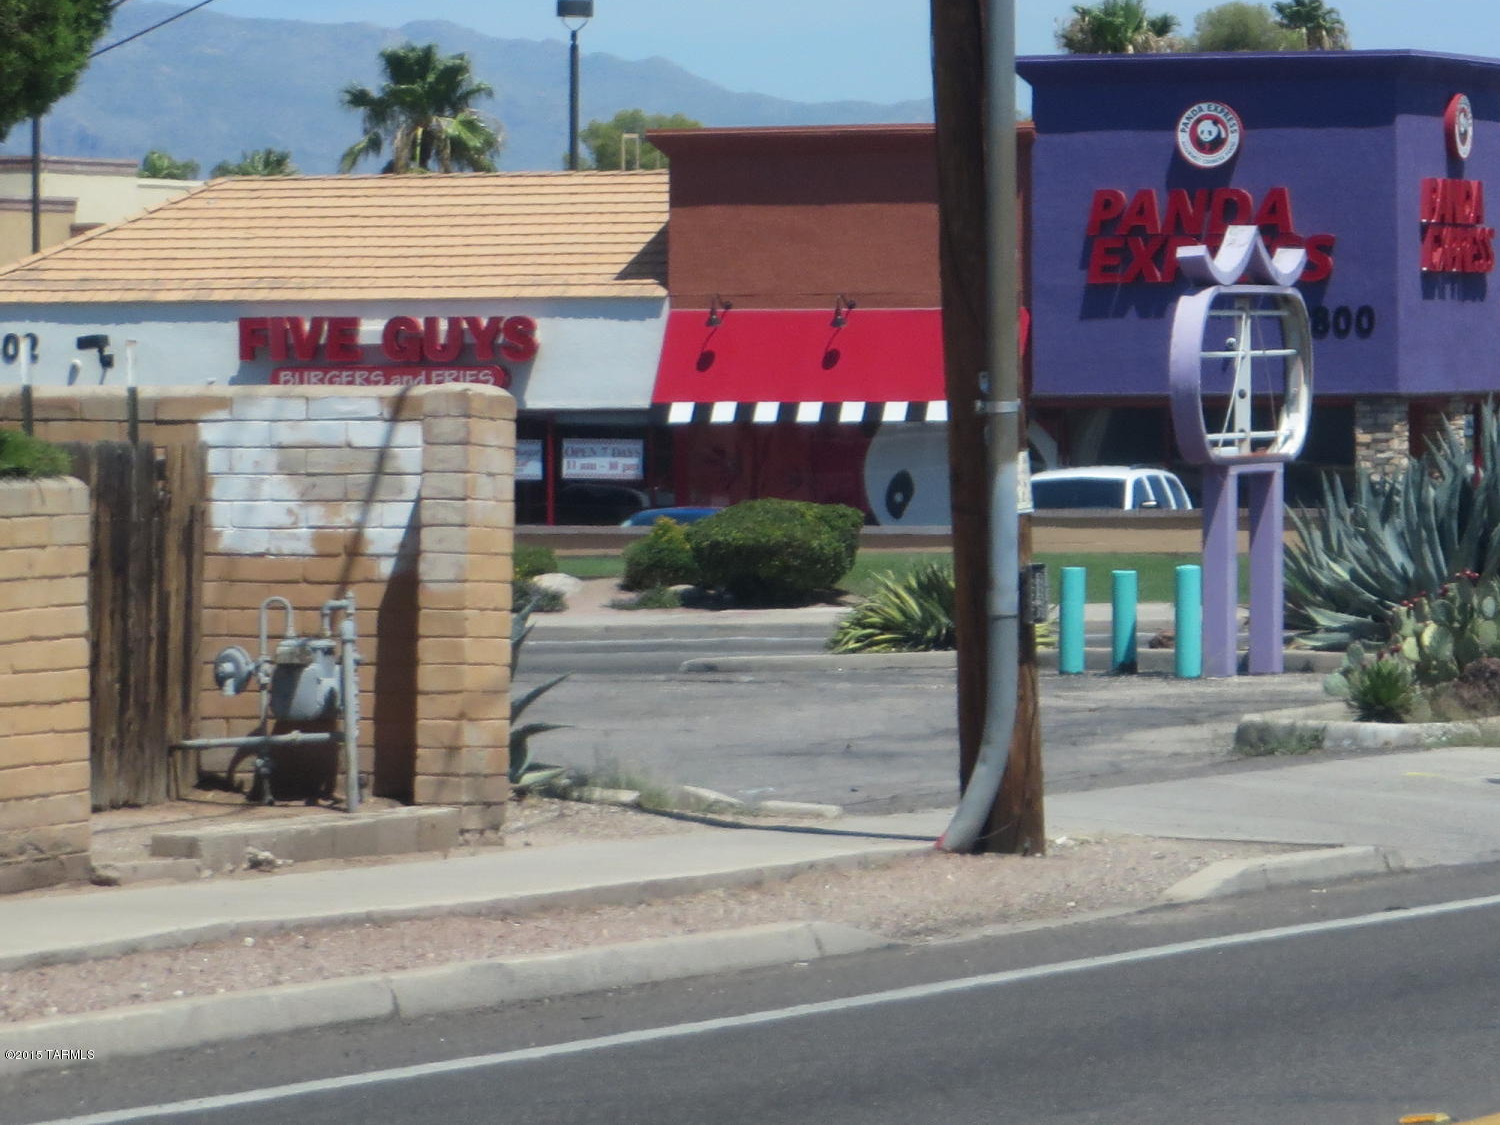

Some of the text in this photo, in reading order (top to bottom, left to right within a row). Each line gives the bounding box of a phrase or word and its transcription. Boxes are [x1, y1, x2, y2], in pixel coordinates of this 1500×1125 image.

[1180, 103, 1238, 134] PANDA EXPRESS
[1087, 187, 1295, 236] PANDA
[1088, 234, 1336, 283] EXPS
[239, 316, 538, 362] FIVE GUYS
[278, 370, 383, 385] BURGERS
